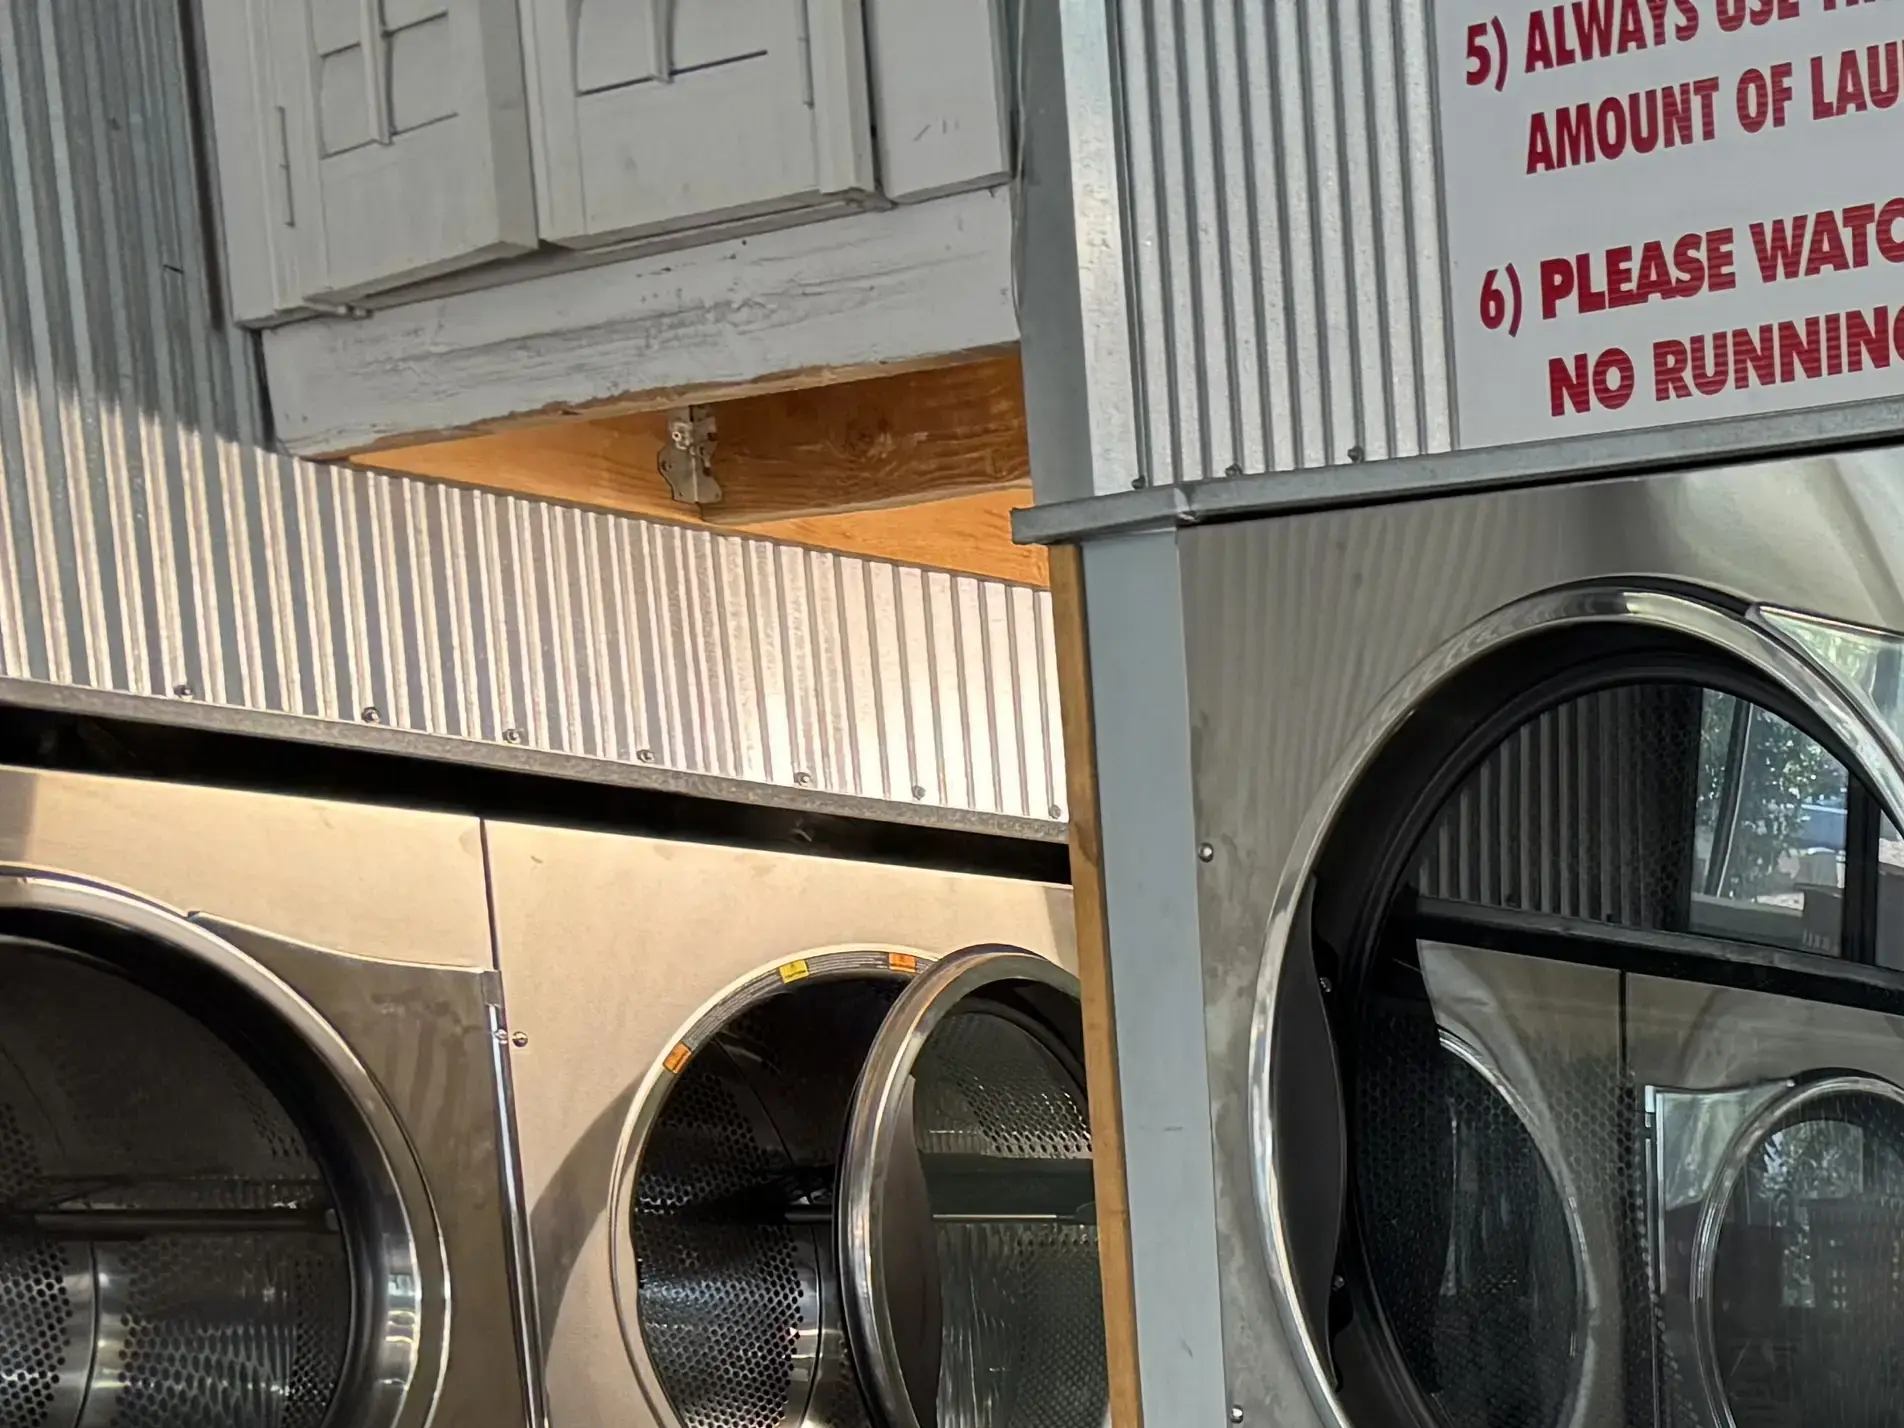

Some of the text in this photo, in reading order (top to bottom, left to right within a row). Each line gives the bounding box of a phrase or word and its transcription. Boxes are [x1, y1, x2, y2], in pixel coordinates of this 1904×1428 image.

[1465, 16, 1508, 92] 5)
[1524, 0, 1700, 74] ALWAYS
[1526, 76, 1719, 175] AMOUNT
[1736, 62, 1793, 134] OF
[1479, 262, 1522, 337] 6)
[1540, 228, 1736, 320] PLEASE
[1548, 347, 1635, 417] NO
